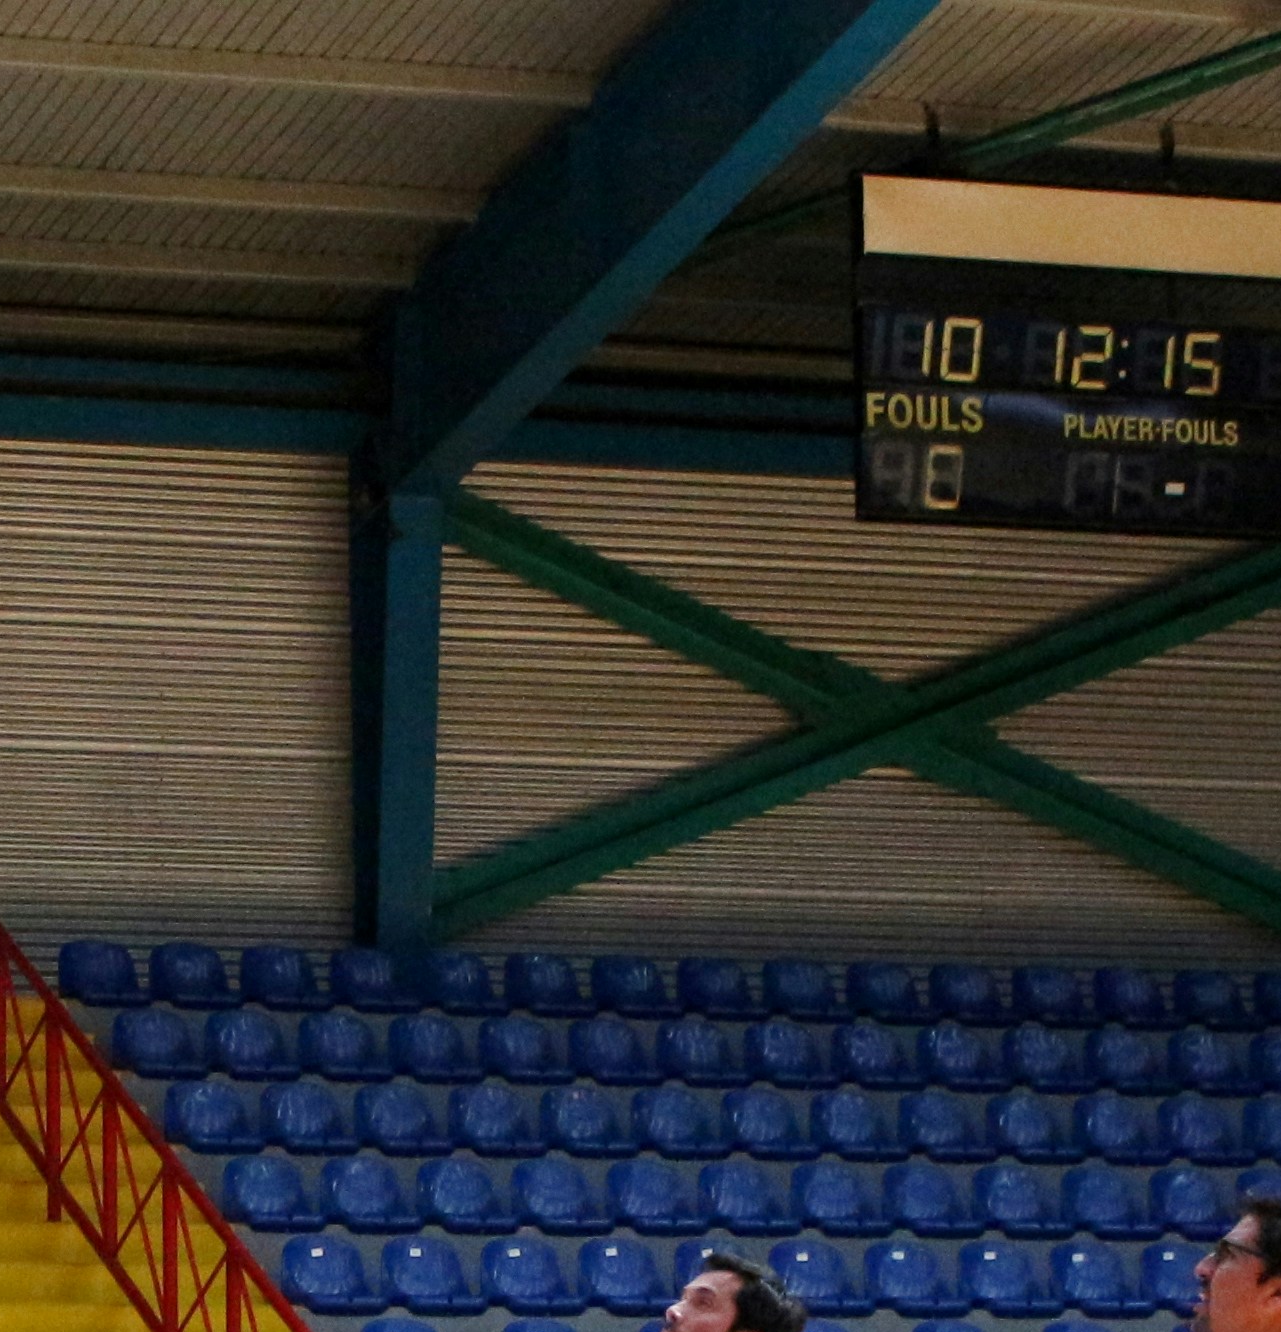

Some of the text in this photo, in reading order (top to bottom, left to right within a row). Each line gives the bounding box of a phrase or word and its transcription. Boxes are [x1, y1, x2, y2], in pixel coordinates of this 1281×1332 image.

[921, 316, 984, 383] 10
[1053, 325, 1220, 397] 12:15
[866, 392, 984, 434] FOULS
